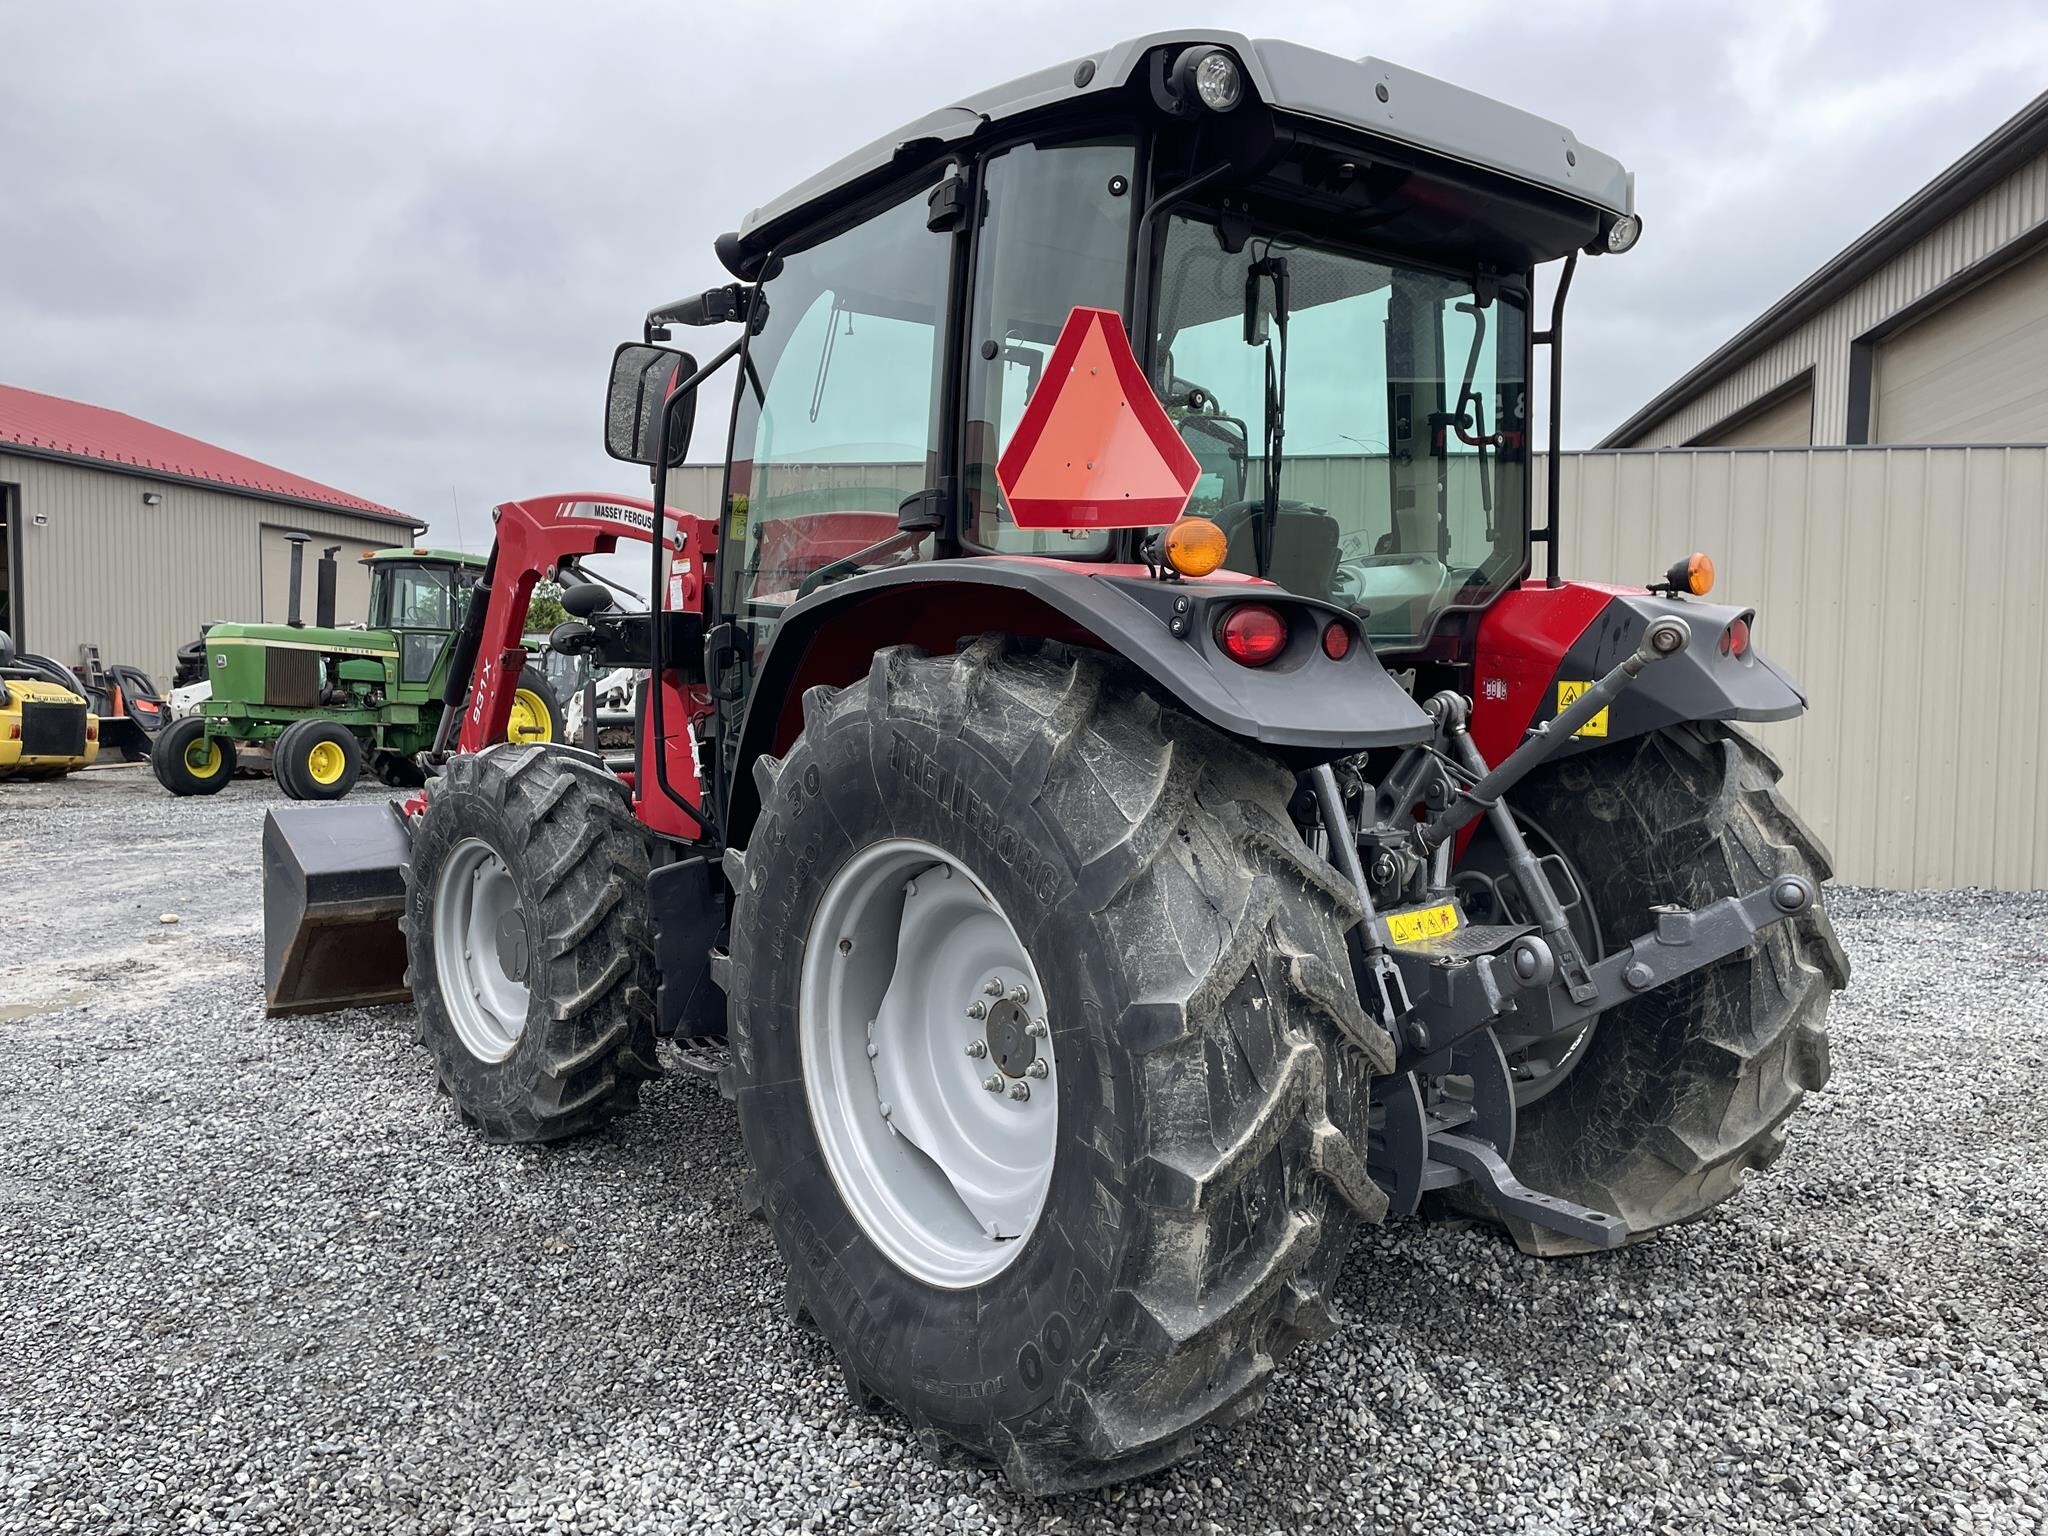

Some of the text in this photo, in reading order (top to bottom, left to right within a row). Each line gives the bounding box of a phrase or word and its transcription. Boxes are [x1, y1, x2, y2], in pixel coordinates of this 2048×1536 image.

[594, 504, 654, 530] MASSEY FERGUS
[784, 763, 823, 820] 30
[889, 728, 1063, 907] TRELLEBORG
